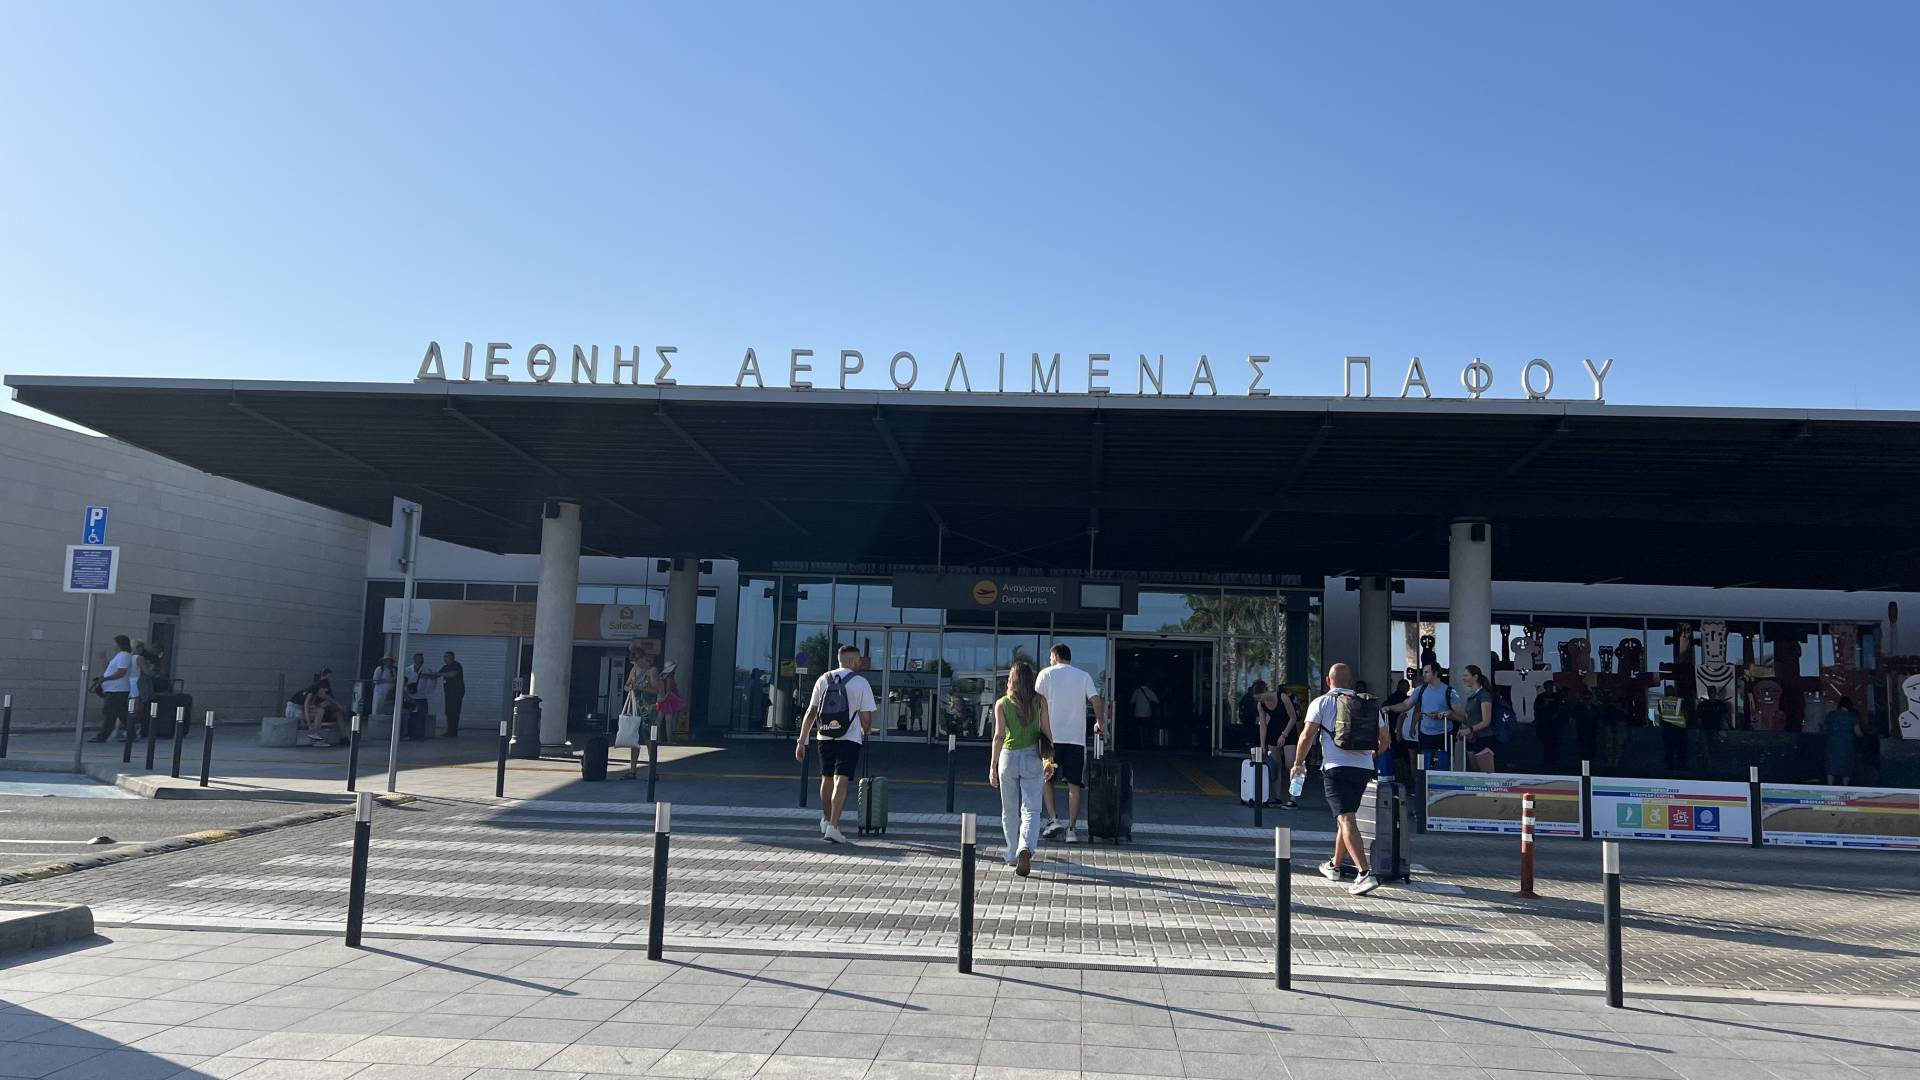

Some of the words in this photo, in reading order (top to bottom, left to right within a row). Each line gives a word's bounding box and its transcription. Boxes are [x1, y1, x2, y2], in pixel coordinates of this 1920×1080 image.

[416, 341, 678, 385] ΔΙΕΘΝΗΣ
[735, 347, 1271, 396] ΑΕΡΟΛΙΜΕΝΑΣ
[1344, 356, 1614, 400] ΠΑΦΟΥ
[90, 508, 103, 526] P
[1002, 583, 1057, 594] Αναχωρήσεις
[1001, 595, 1048, 605] Departures
